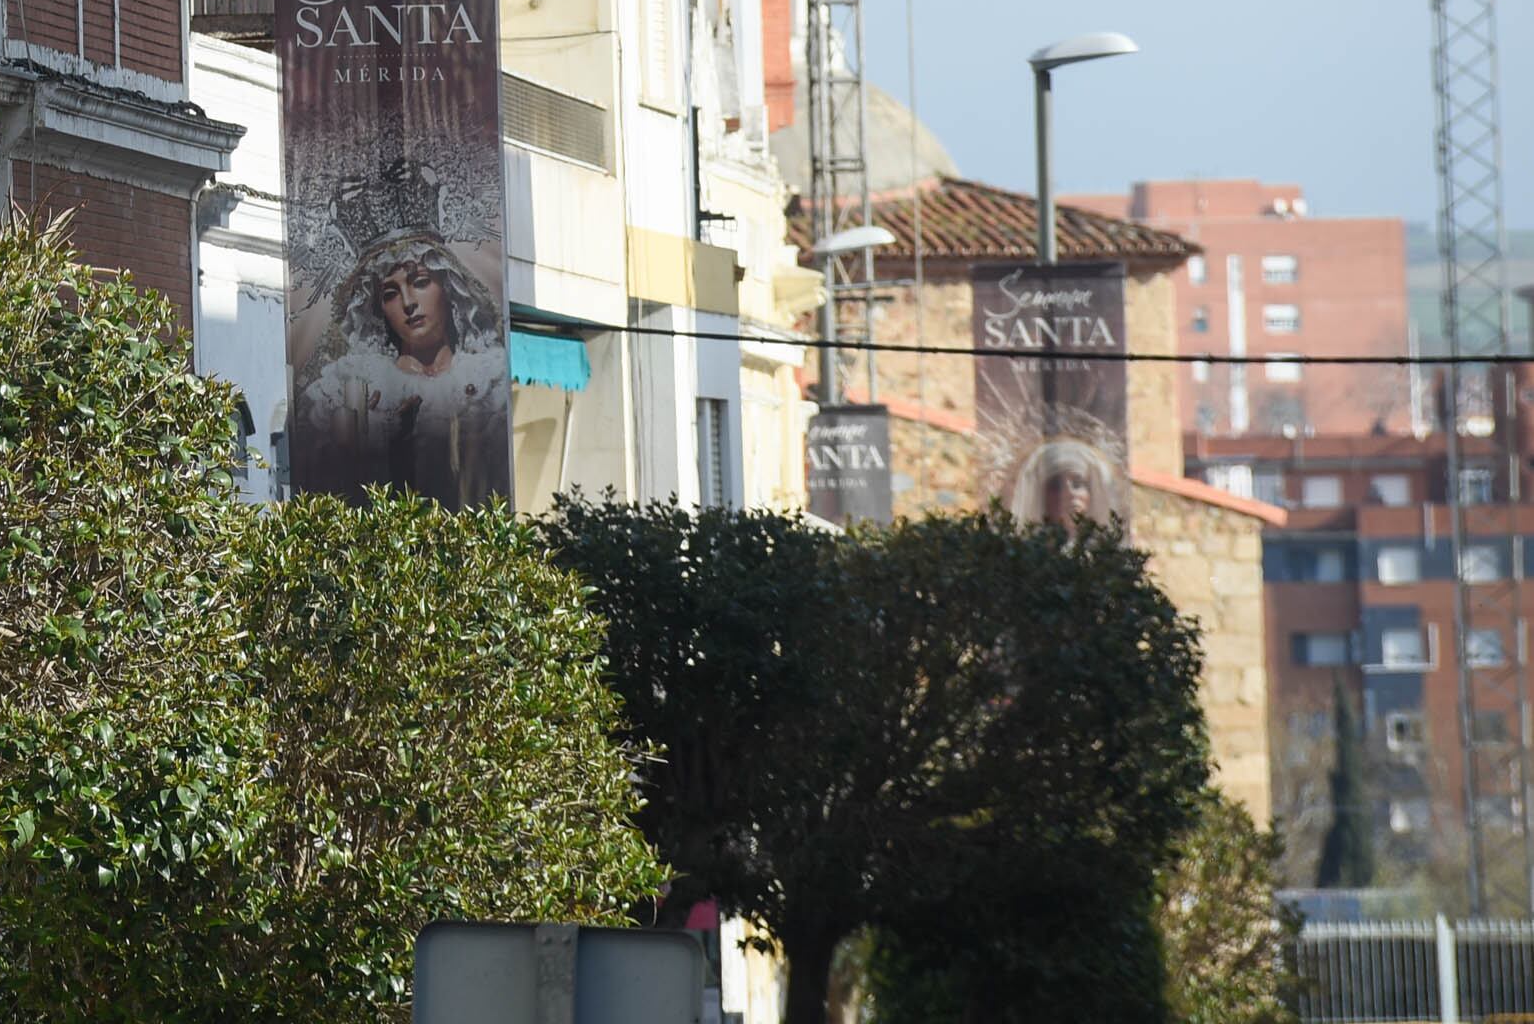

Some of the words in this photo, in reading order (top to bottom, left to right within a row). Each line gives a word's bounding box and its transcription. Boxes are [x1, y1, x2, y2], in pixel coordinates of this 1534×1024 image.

[295, 2, 483, 48] SANTA
[334, 65, 445, 84] MÉRIDA
[984, 316, 1116, 348] SANTA
[807, 444, 886, 471] ANTA
